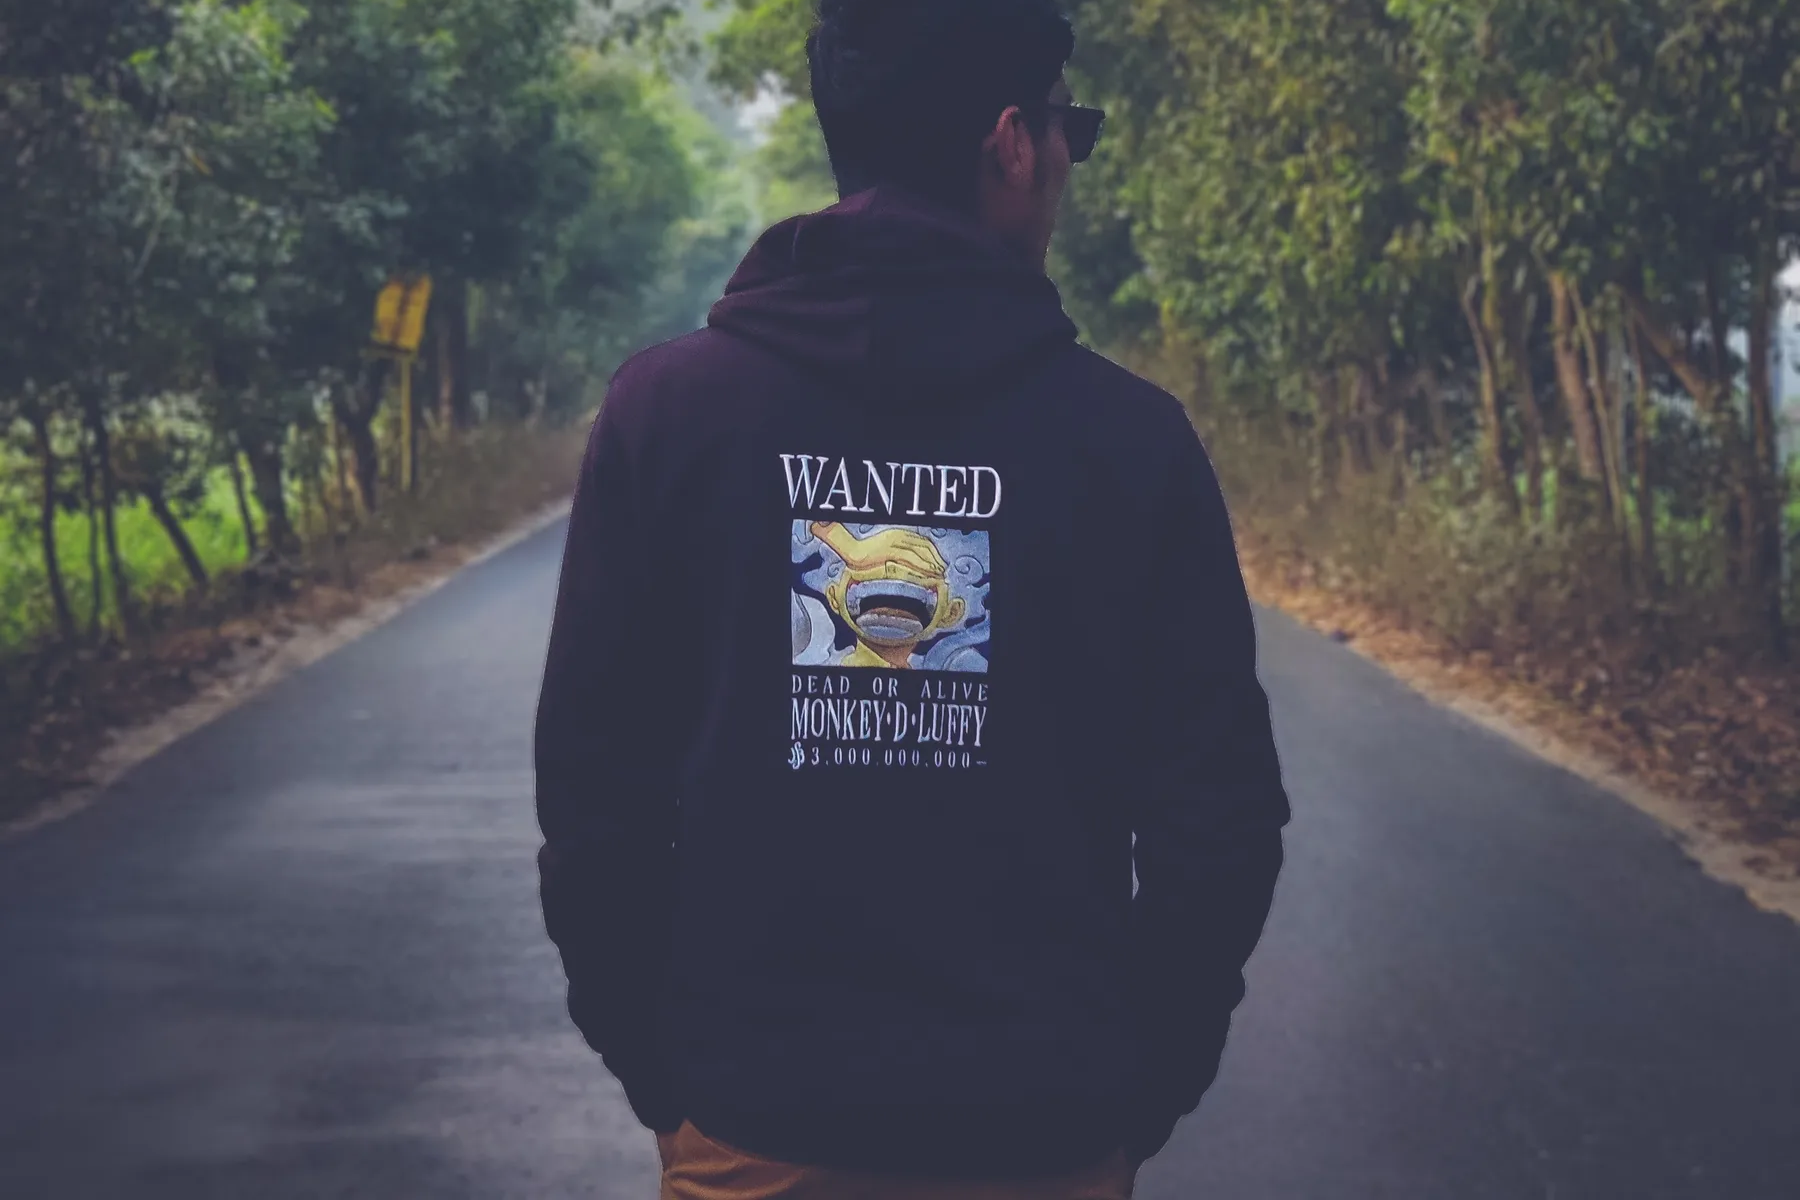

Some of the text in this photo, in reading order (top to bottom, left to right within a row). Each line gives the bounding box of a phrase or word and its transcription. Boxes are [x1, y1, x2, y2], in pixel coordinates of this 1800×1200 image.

[779, 454, 1002, 518] WANTED
[791, 674, 988, 701] DEAD OR ALIVE
